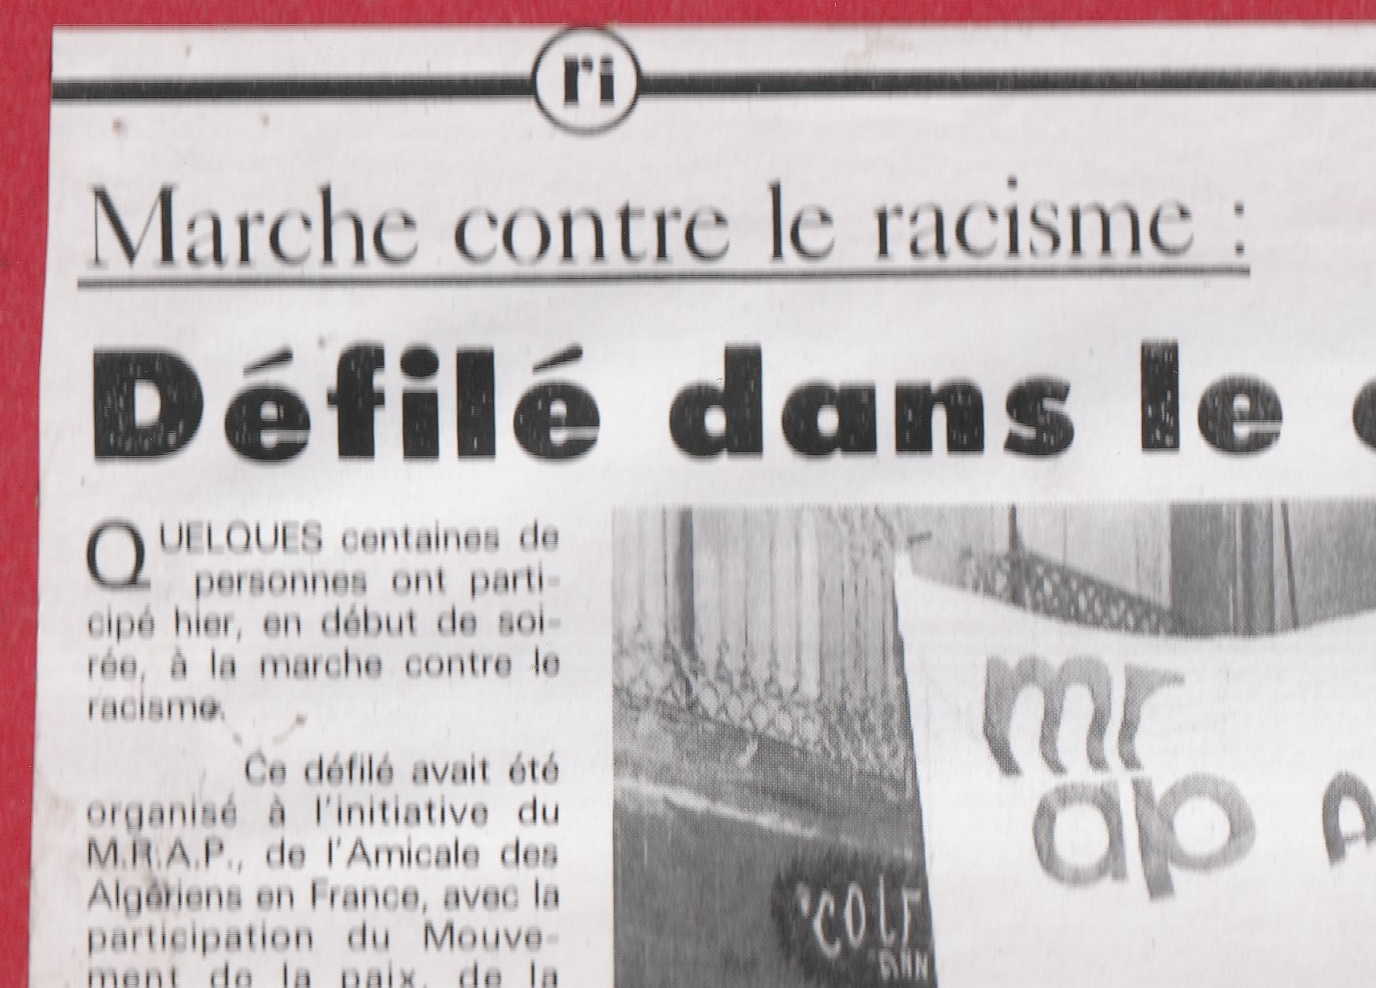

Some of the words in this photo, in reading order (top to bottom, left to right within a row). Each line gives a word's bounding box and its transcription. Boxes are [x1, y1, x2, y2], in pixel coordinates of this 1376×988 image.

[91, 181, 418, 269] Marche
[453, 201, 730, 264] contre
[768, 179, 835, 264] le
[874, 175, 1195, 264] racisme
[92, 342, 601, 466] Défilé
[668, 343, 1075, 462] dans
[1139, 340, 1284, 458] le
[340, 521, 501, 554] centaines
[518, 518, 560, 552] de
[194, 570, 368, 598] personnes
[391, 566, 446, 595] ont
[86, 606, 156, 640] cipé
[173, 606, 242, 640] hier,
[320, 606, 417, 638] début
[436, 606, 478, 637] de
[87, 647, 146, 682] rée,
[259, 647, 383, 680] marche
[404, 649, 513, 679] contre
[532, 647, 561, 678] le
[87, 690, 226, 723] racisme.
[243, 750, 288, 786] Ce
[303, 752, 395, 787] défilé
[411, 752, 490, 787] avait
[507, 750, 560, 786] été
[86, 795, 238, 834] organisé
[516, 795, 560, 827] du
[264, 836, 307, 870] de
[499, 835, 559, 870] des
[87, 875, 243, 916] Algériens
[310, 877, 428, 916] France,
[442, 885, 519, 912] avec
[86, 920, 314, 954] participation
[346, 919, 391, 952] du
